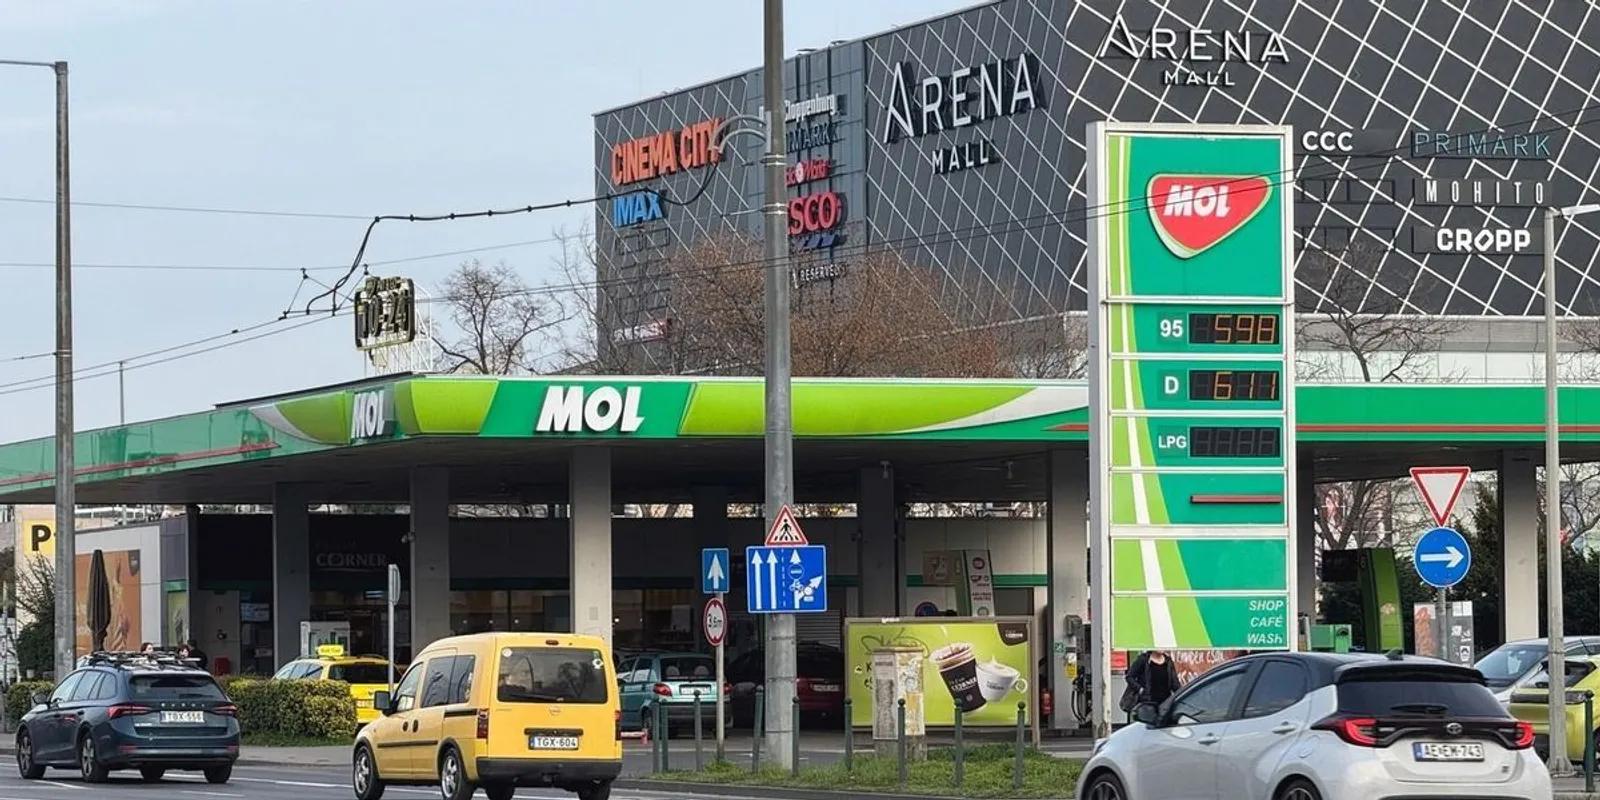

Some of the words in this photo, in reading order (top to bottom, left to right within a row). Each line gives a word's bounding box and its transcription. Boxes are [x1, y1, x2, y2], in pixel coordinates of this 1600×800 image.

[1100, 13, 1290, 62] ARENA
[1164, 70, 1236, 86] MALL
[884, 53, 1036, 144] ARENA
[786, 122, 833, 154] MARK
[1302, 130, 1353, 151] CCC
[1415, 132, 1551, 156] PRIMARK
[611, 131, 677, 186] CINEMA
[932, 139, 989, 175] MALL
[1163, 185, 1231, 217] MOL
[1426, 180, 1544, 203] MOHITO
[613, 189, 662, 227] IMAX
[786, 192, 838, 235] SCO
[1437, 228, 1531, 252] CROPP
[1160, 320, 1183, 337] 95
[1214, 314, 1276, 343] 598
[1164, 376, 1179, 394] D
[1213, 371, 1276, 400] 611
[353, 390, 385, 438] MOL
[536, 386, 644, 432] MOL
[1158, 435, 1187, 449] LPG
[32, 525, 56, 551] P
[1249, 601, 1283, 611] SHOP
[1251, 615, 1283, 627] CAFÉ
[537, 737, 576, 747] TGX-604
